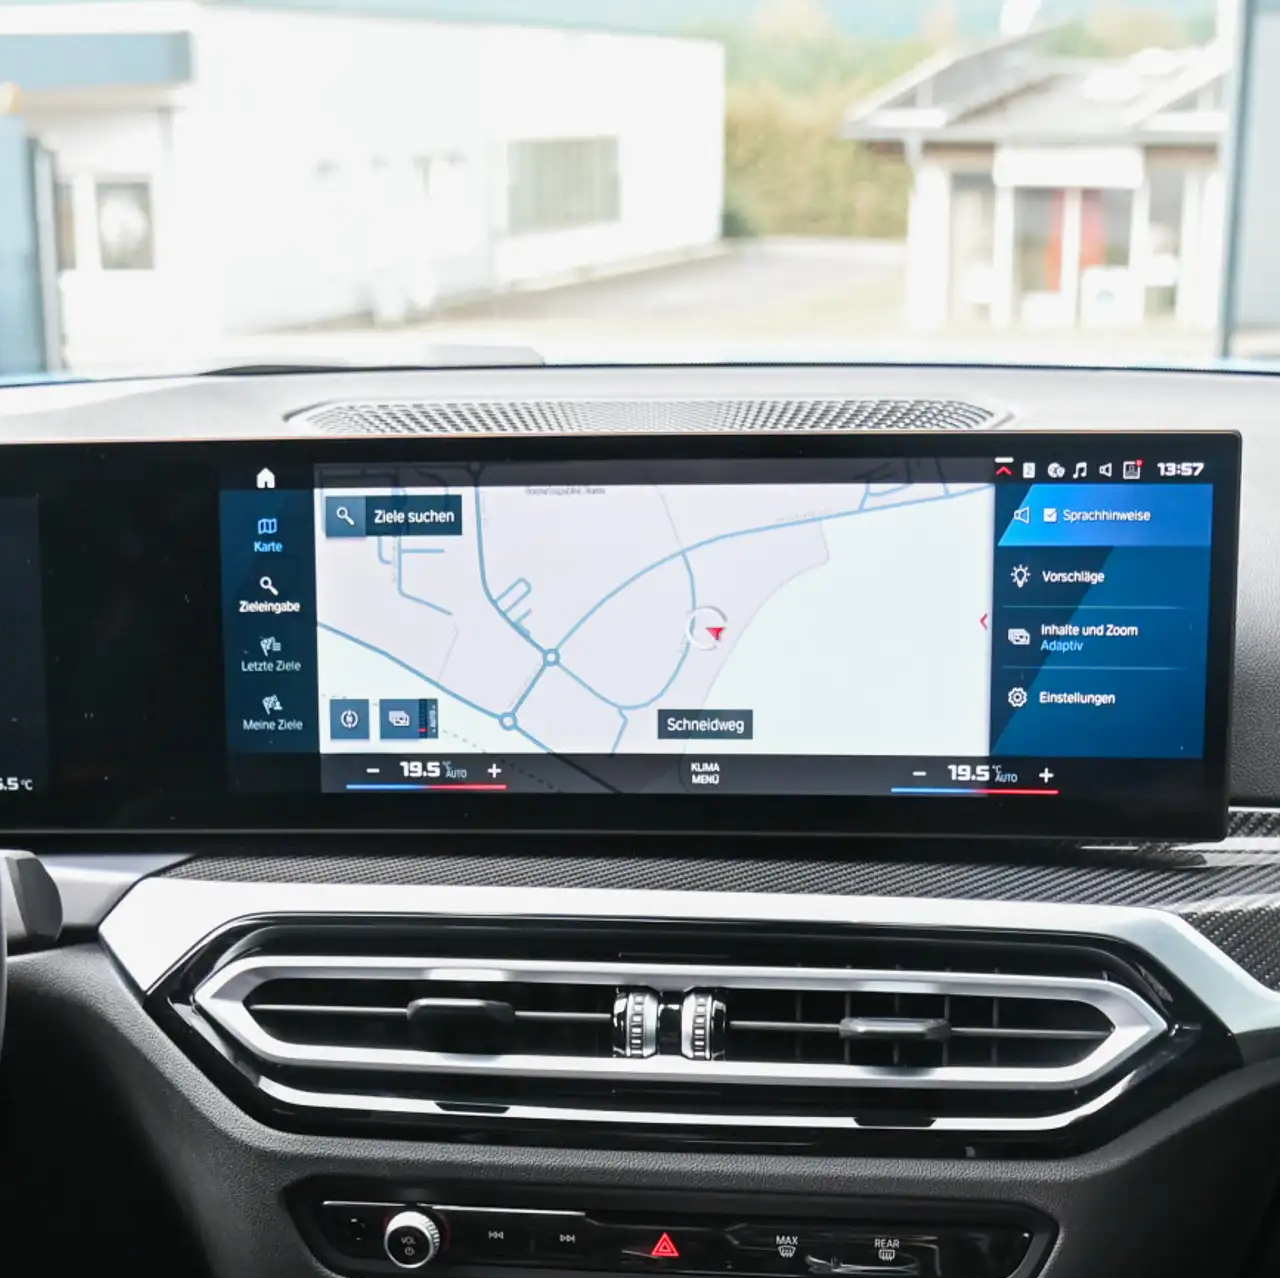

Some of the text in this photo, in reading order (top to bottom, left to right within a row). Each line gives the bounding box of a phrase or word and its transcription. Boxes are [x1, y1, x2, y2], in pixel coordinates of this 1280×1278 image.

[1157, 462, 1205, 477] 13:57
[373, 508, 455, 524] Ziele suchen
[1062, 508, 1151, 523] Sprachhinweise
[253, 540, 283, 553] Karte
[1042, 569, 1105, 585] Vorschläge
[238, 600, 301, 614] Zieleingabe
[1040, 623, 1139, 637] Inhalte und Zoom
[1040, 639, 1084, 653] Adaptiv
[240, 660, 302, 673] Letzte Ziele
[1039, 691, 1116, 706] Einstellungen
[242, 718, 303, 732] Meine Ziele
[666, 716, 745, 734] Schneidweg
[399, 761, 441, 778] 19.5
[690, 763, 720, 772] KLIMA
[947, 765, 990, 782] 19.5
[400, 1236, 417, 1245] VOL
[775, 1235, 799, 1245] MAX
[874, 1238, 900, 1249] REAR
